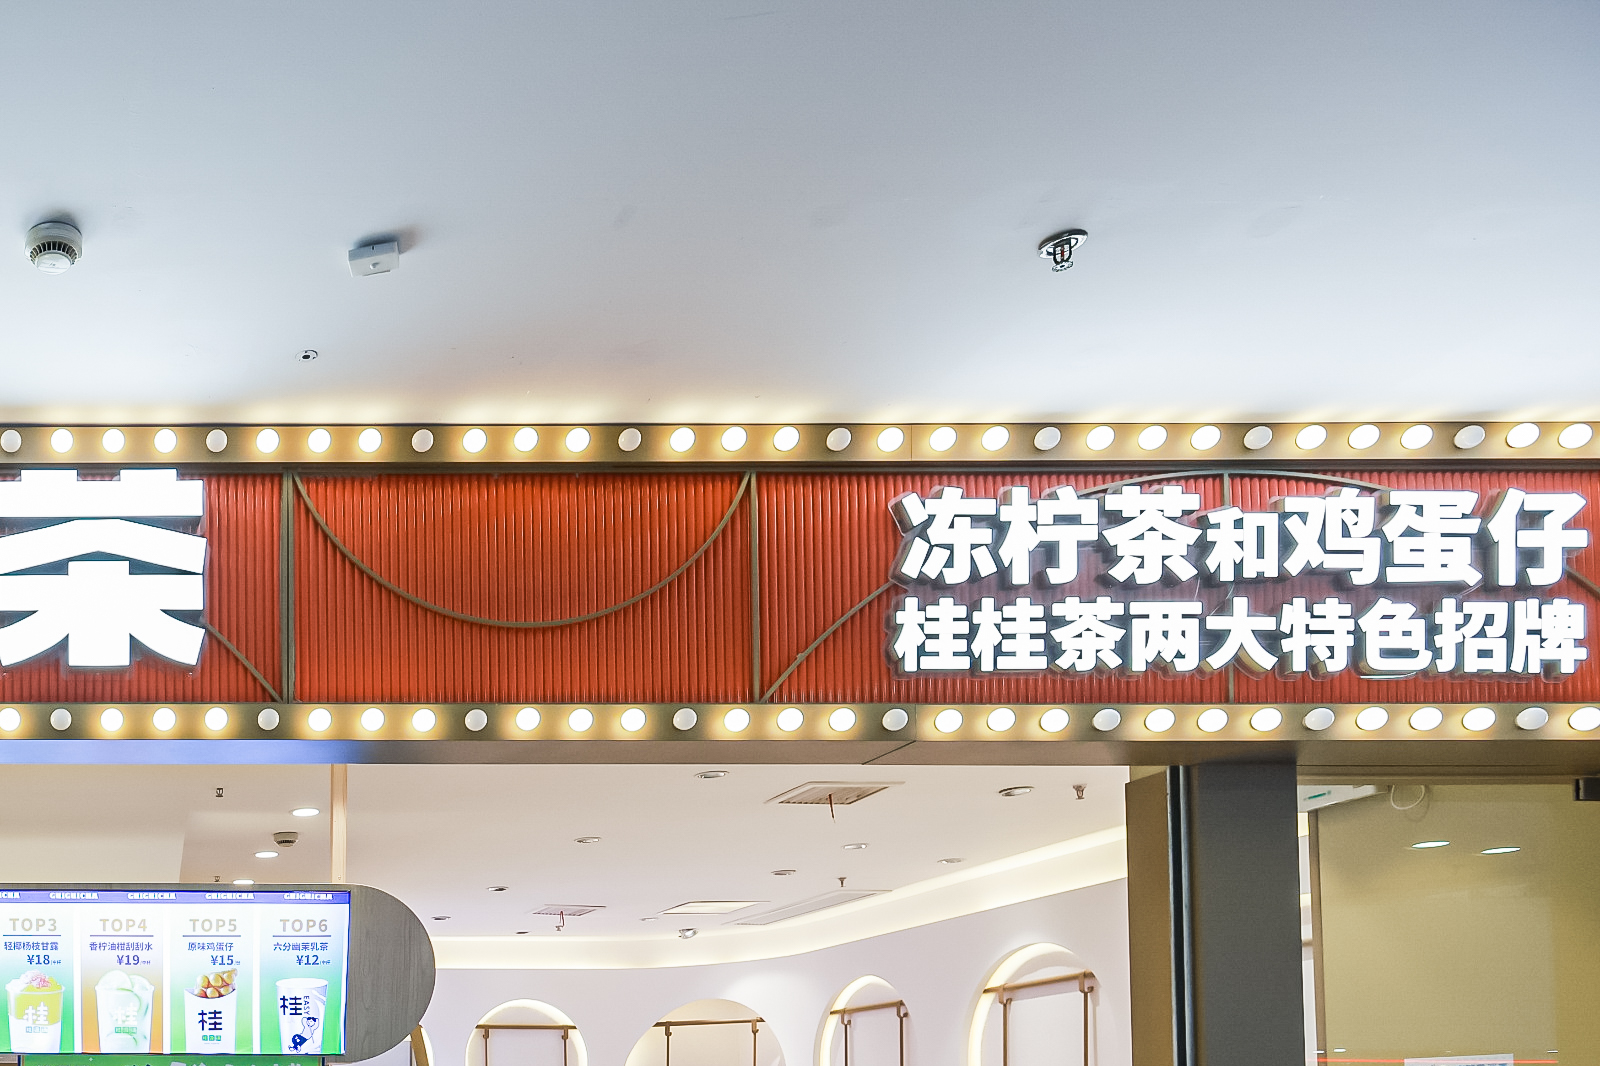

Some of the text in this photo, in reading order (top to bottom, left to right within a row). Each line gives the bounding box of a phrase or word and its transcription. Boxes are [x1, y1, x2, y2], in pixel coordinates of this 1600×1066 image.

[899, 486, 1588, 587] 冻柠茶和鸡蛋仔
[895, 596, 1587, 673] 桂桂茶两大特色招牌
[9, 918, 57, 932] TOP3
[99, 918, 147, 932] TOP4
[189, 918, 237, 932] TOP5
[280, 919, 328, 932] TOP6
[187, 942, 234, 951] 原味鸡蛋仔
[23, 1001, 49, 1025] 桂
[279, 995, 303, 1016] 桂
[198, 1009, 223, 1031] 桂
